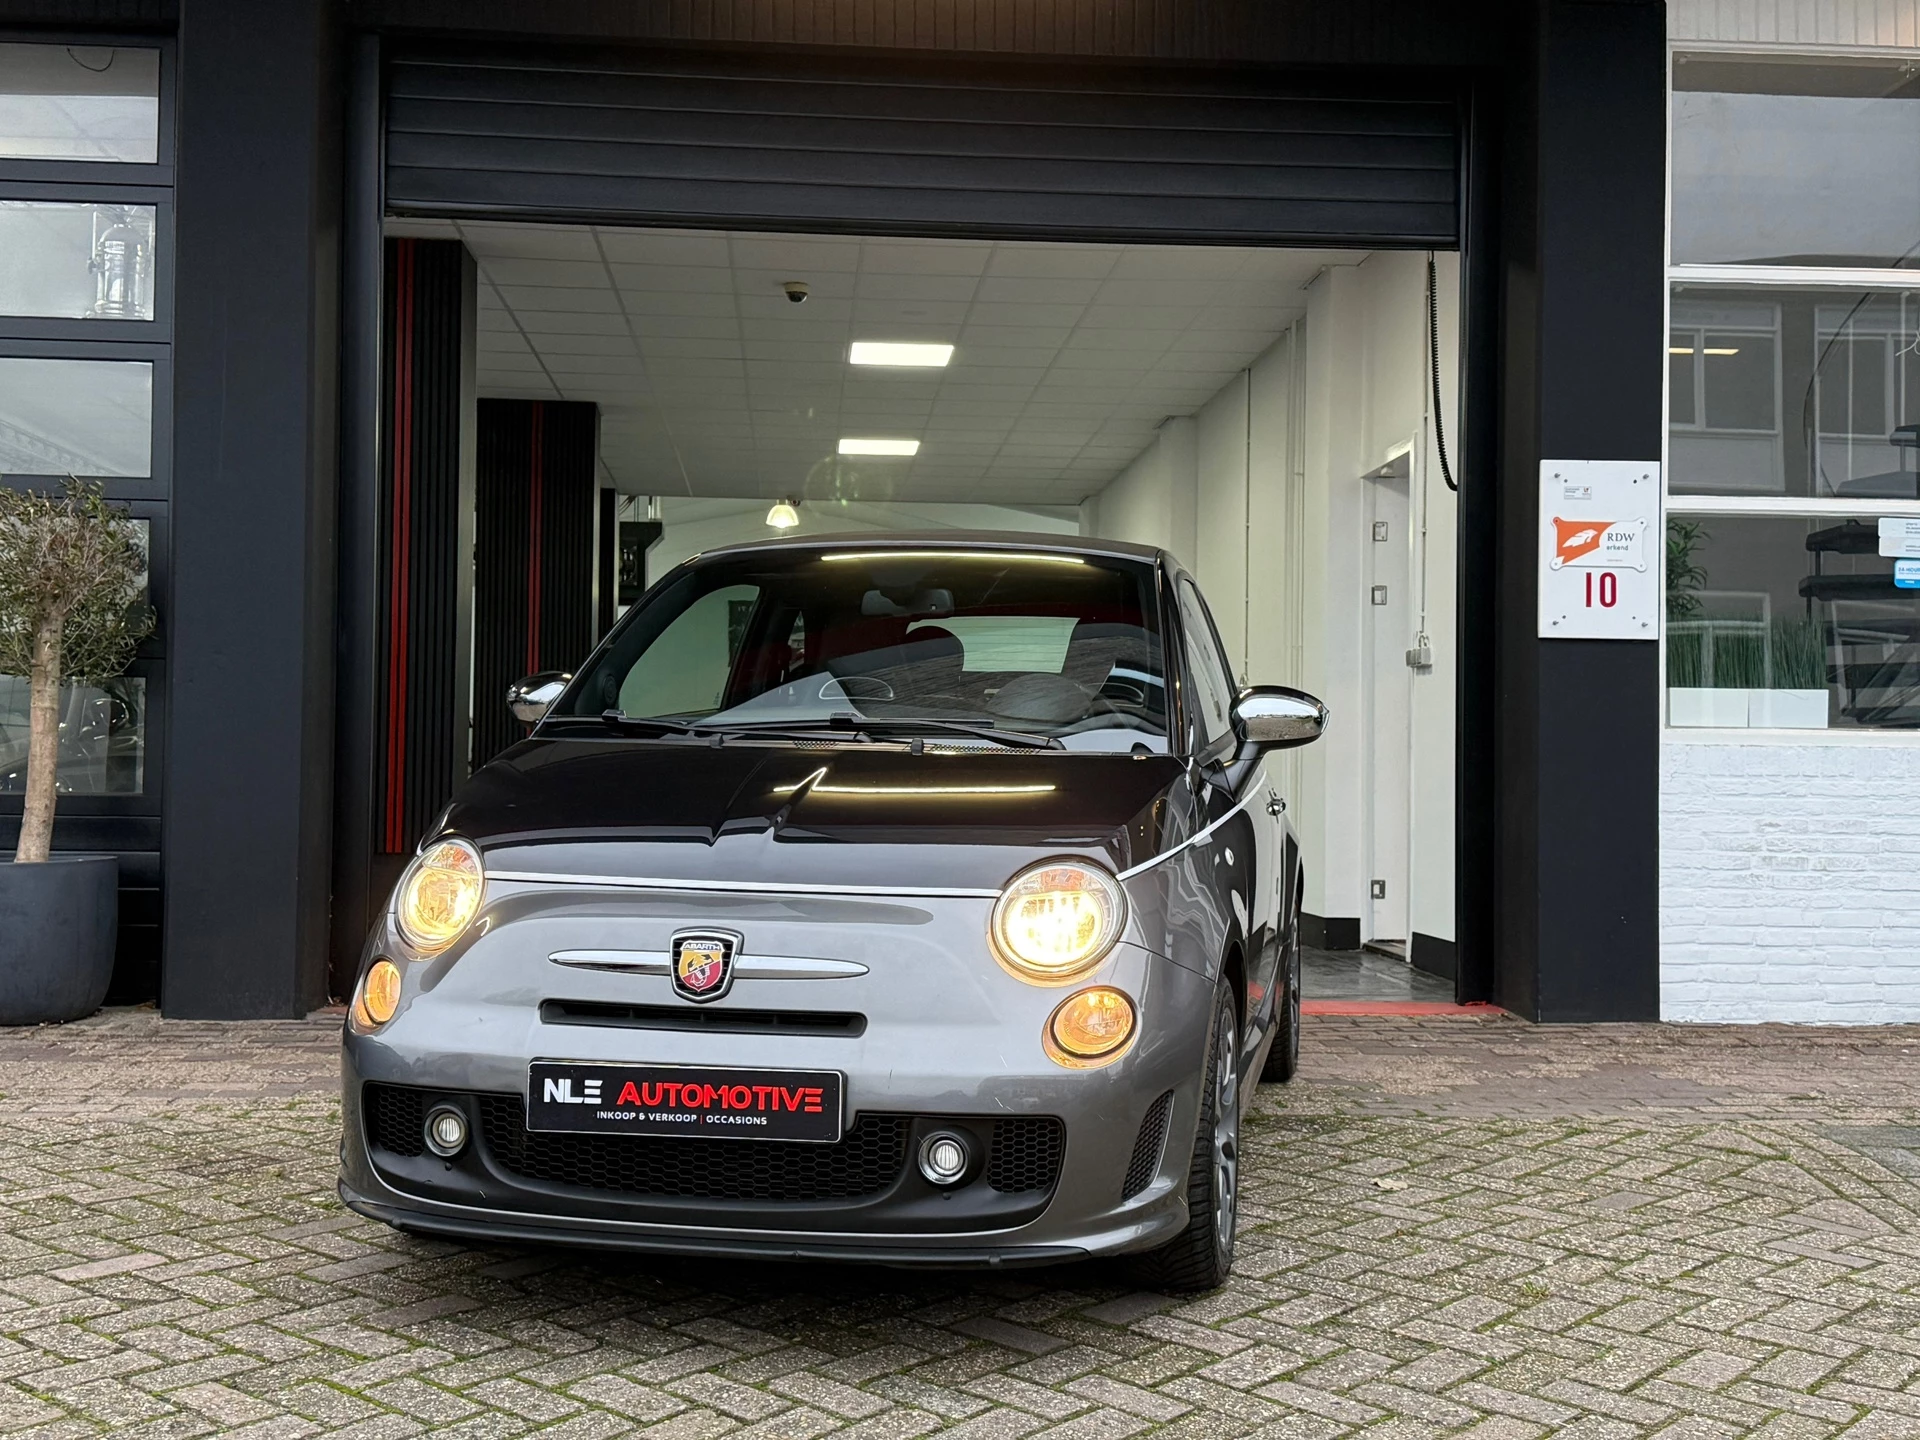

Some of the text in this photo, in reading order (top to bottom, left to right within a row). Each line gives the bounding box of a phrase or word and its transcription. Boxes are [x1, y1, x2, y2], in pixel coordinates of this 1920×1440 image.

[1607, 532, 1635, 542] RDW
[1585, 572, 1617, 608] 10
[543, 1078, 824, 1112] NLE AUTOMOTIVE
[596, 1111, 768, 1126] INKOOP & VERKOOP OCCASIONS
